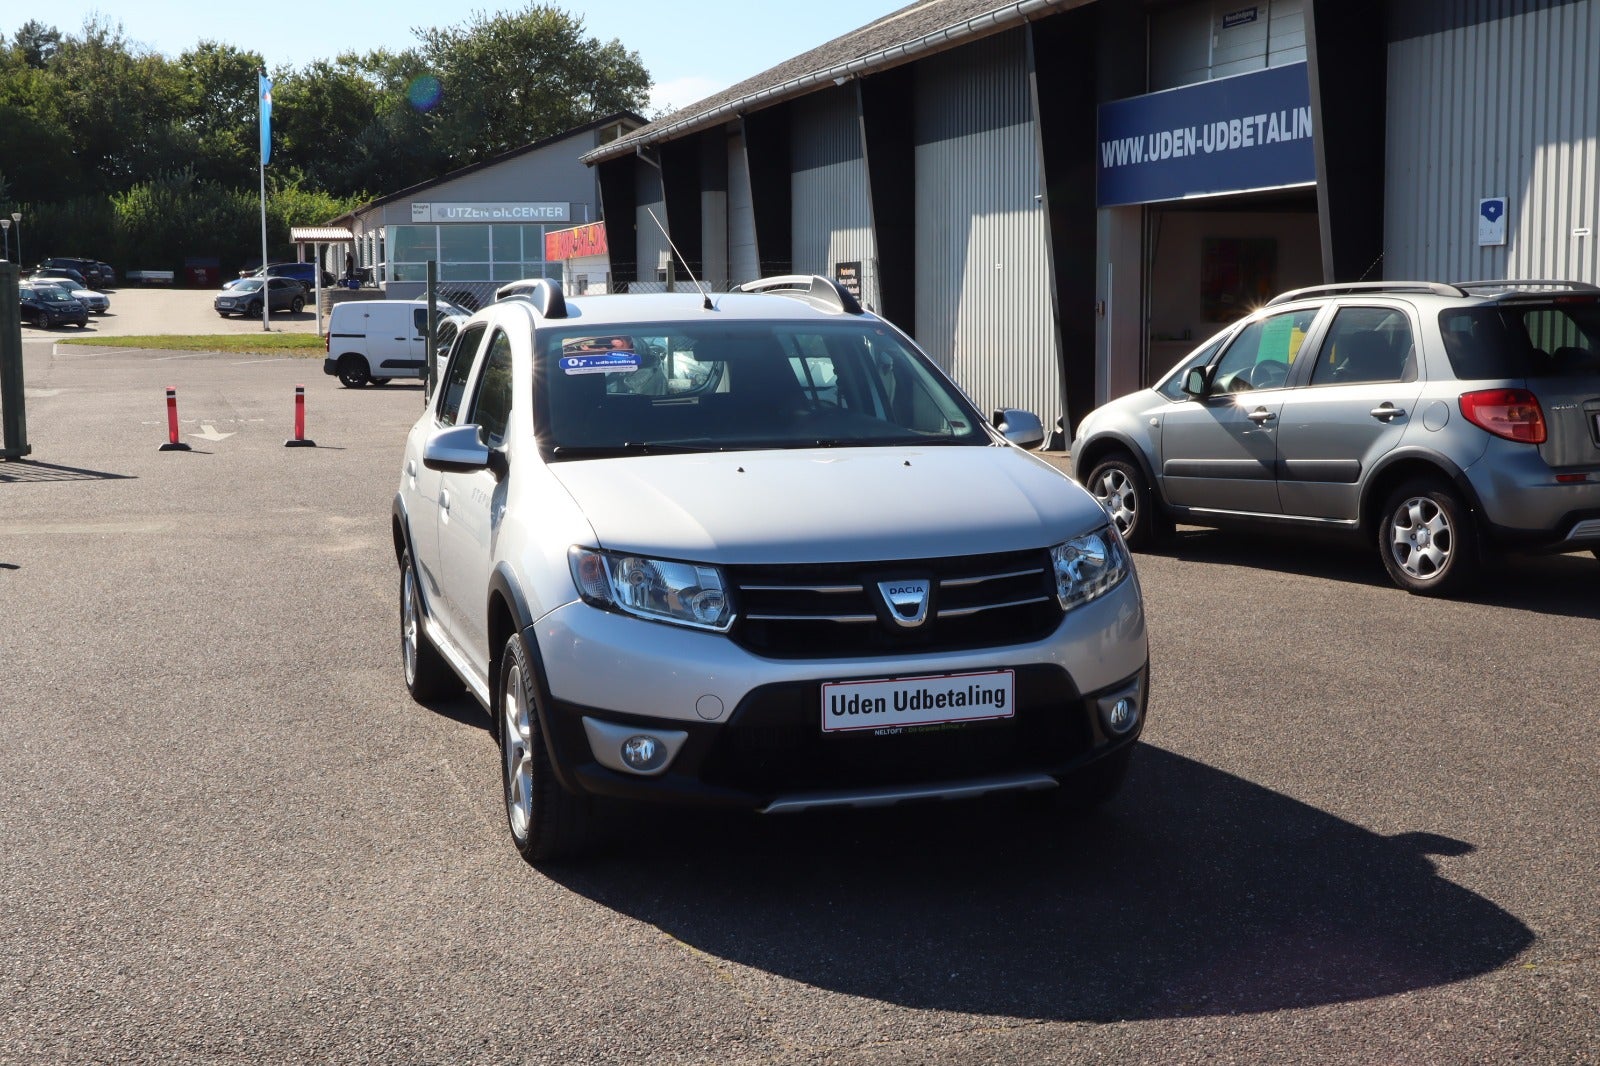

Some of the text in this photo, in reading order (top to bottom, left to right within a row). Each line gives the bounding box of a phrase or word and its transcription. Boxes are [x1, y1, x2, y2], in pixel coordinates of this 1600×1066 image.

[889, 586, 924, 595] DACIA
[831, 685, 1006, 716] Uden Udbetaling
[874, 727, 903, 736] NELTOFT
